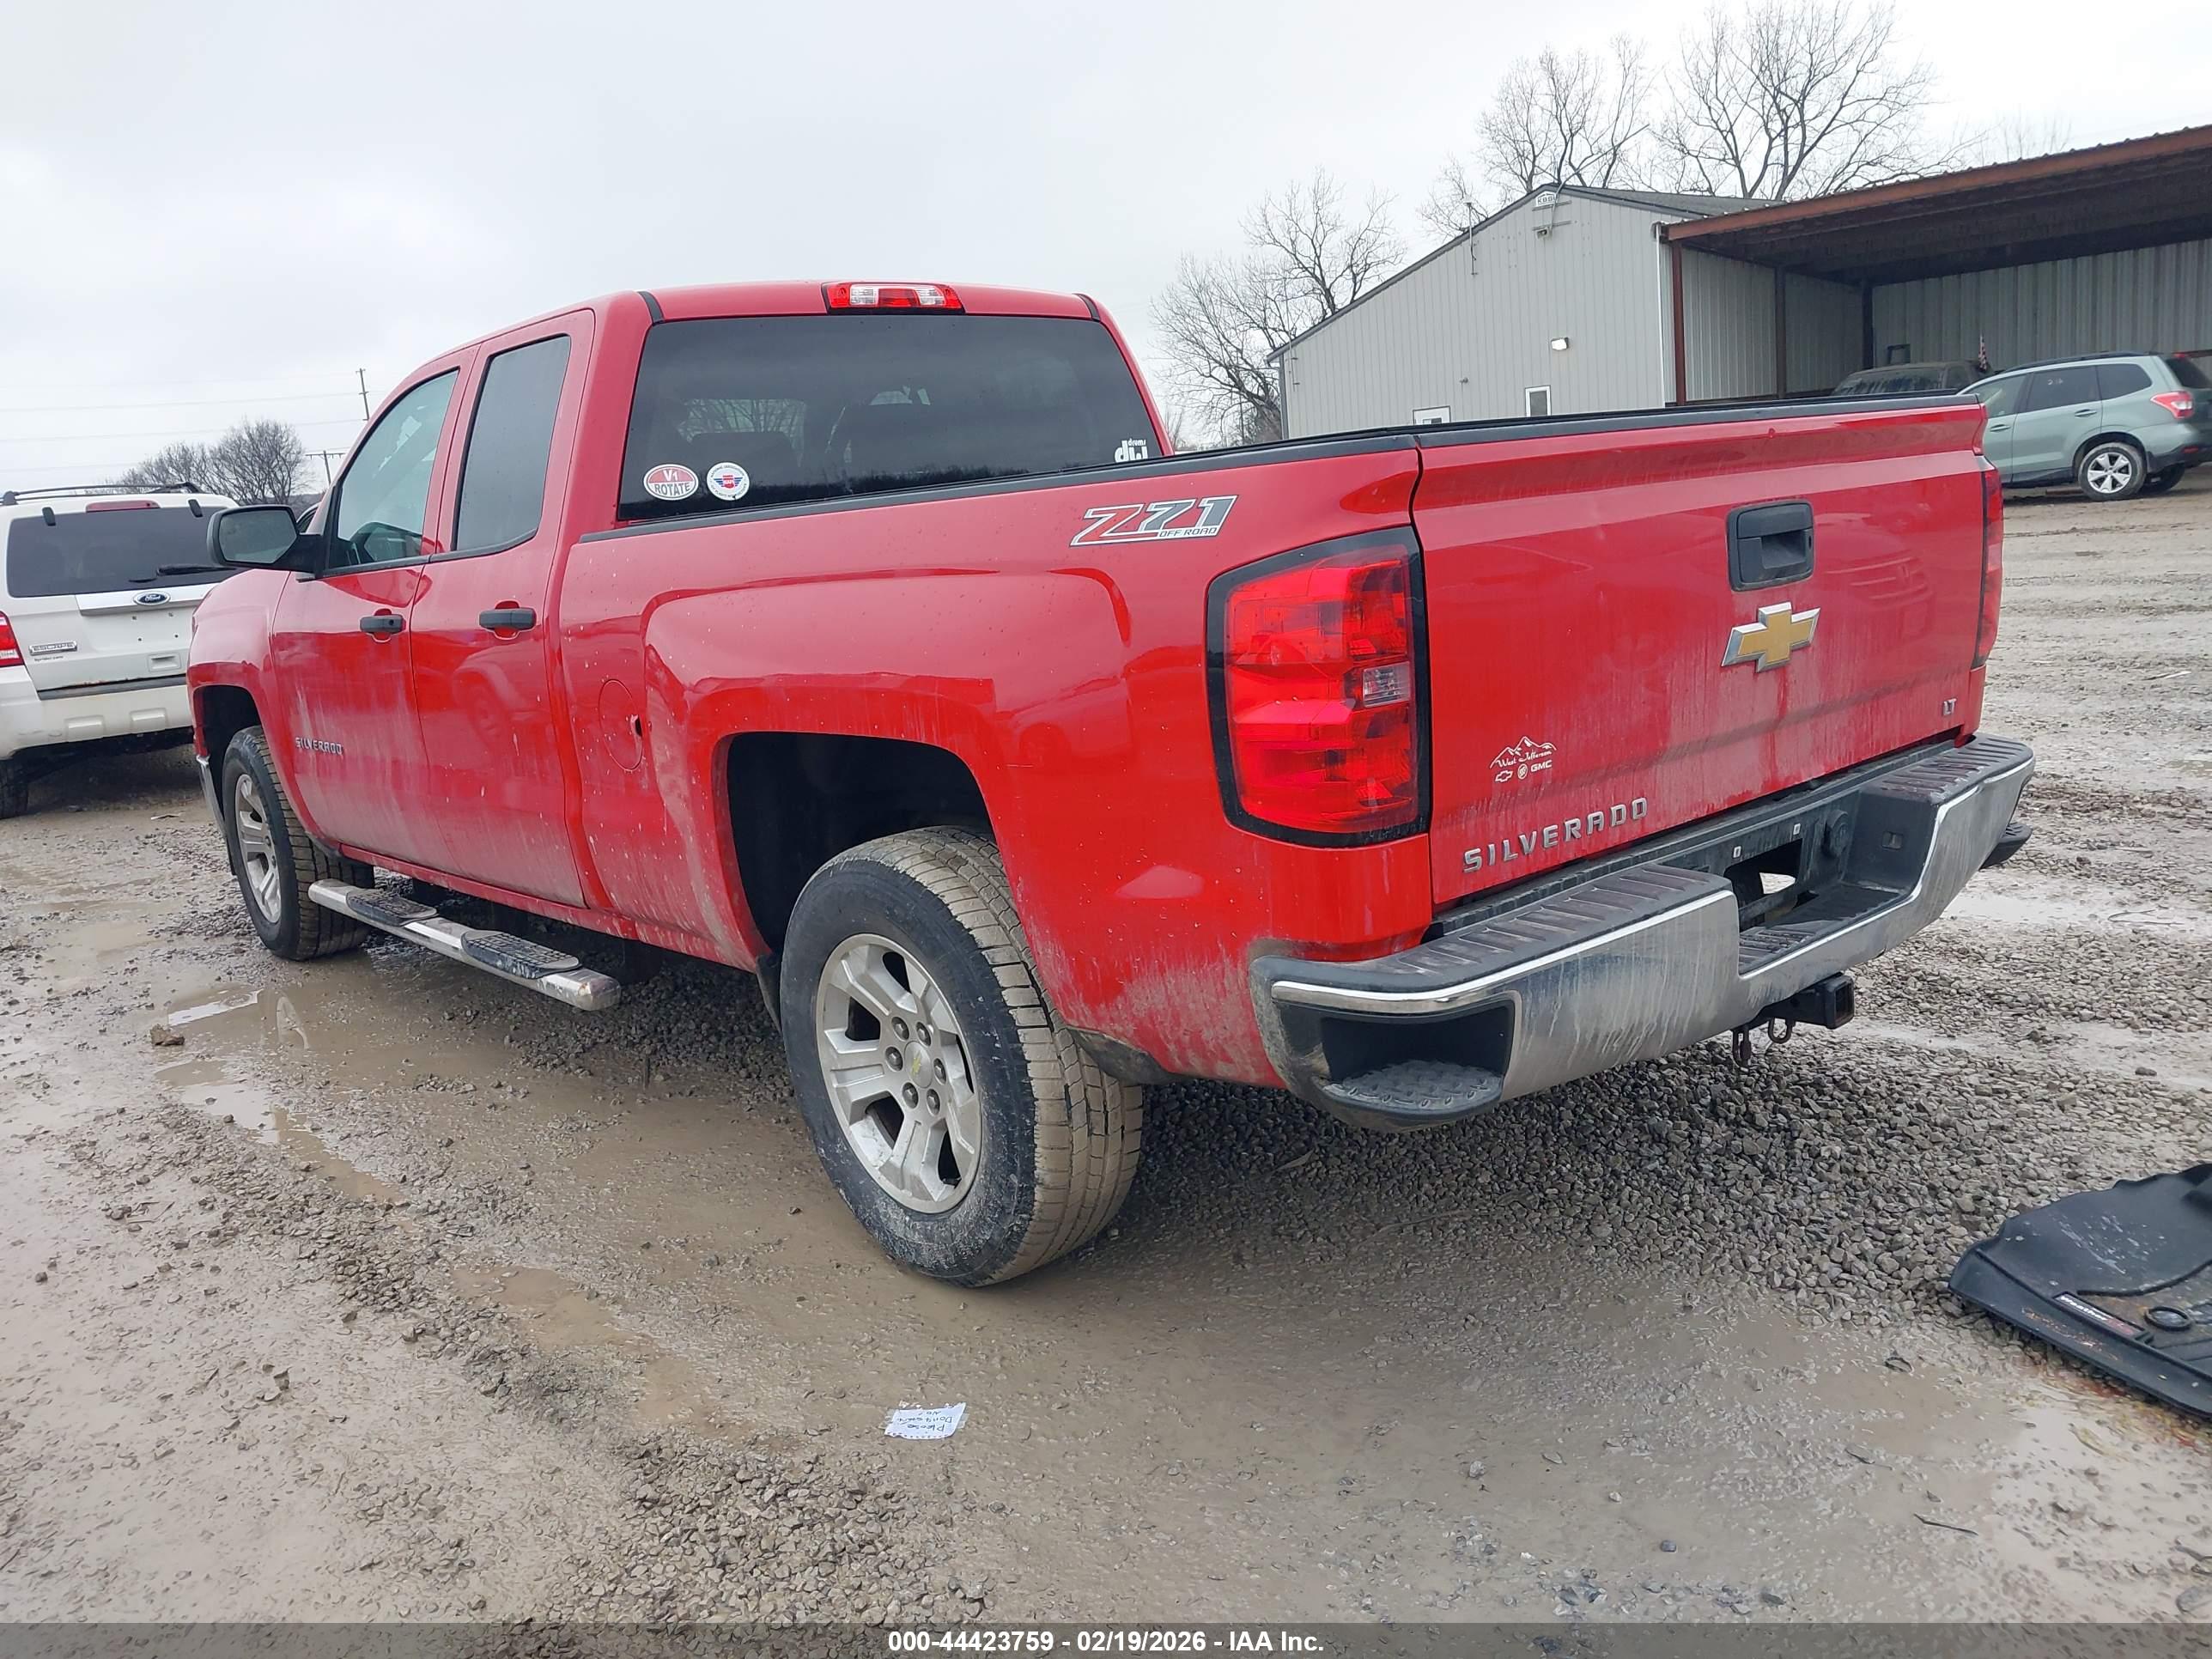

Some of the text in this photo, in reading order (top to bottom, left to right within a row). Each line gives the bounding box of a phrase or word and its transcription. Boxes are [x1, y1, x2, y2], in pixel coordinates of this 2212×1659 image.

[1127, 438, 1146, 447] drums
[662, 469, 679, 482] V1
[653, 482, 690, 496] ROTATE
[1069, 495, 1239, 548] Z71
[1159, 526, 1218, 538] OFF ROAD
[1942, 697, 1957, 715] LT
[295, 737, 343, 755] SILVERADO
[1496, 757, 1517, 768] West
[1530, 759, 1553, 773] GMC
[1462, 796, 1648, 874] SILVERADO
